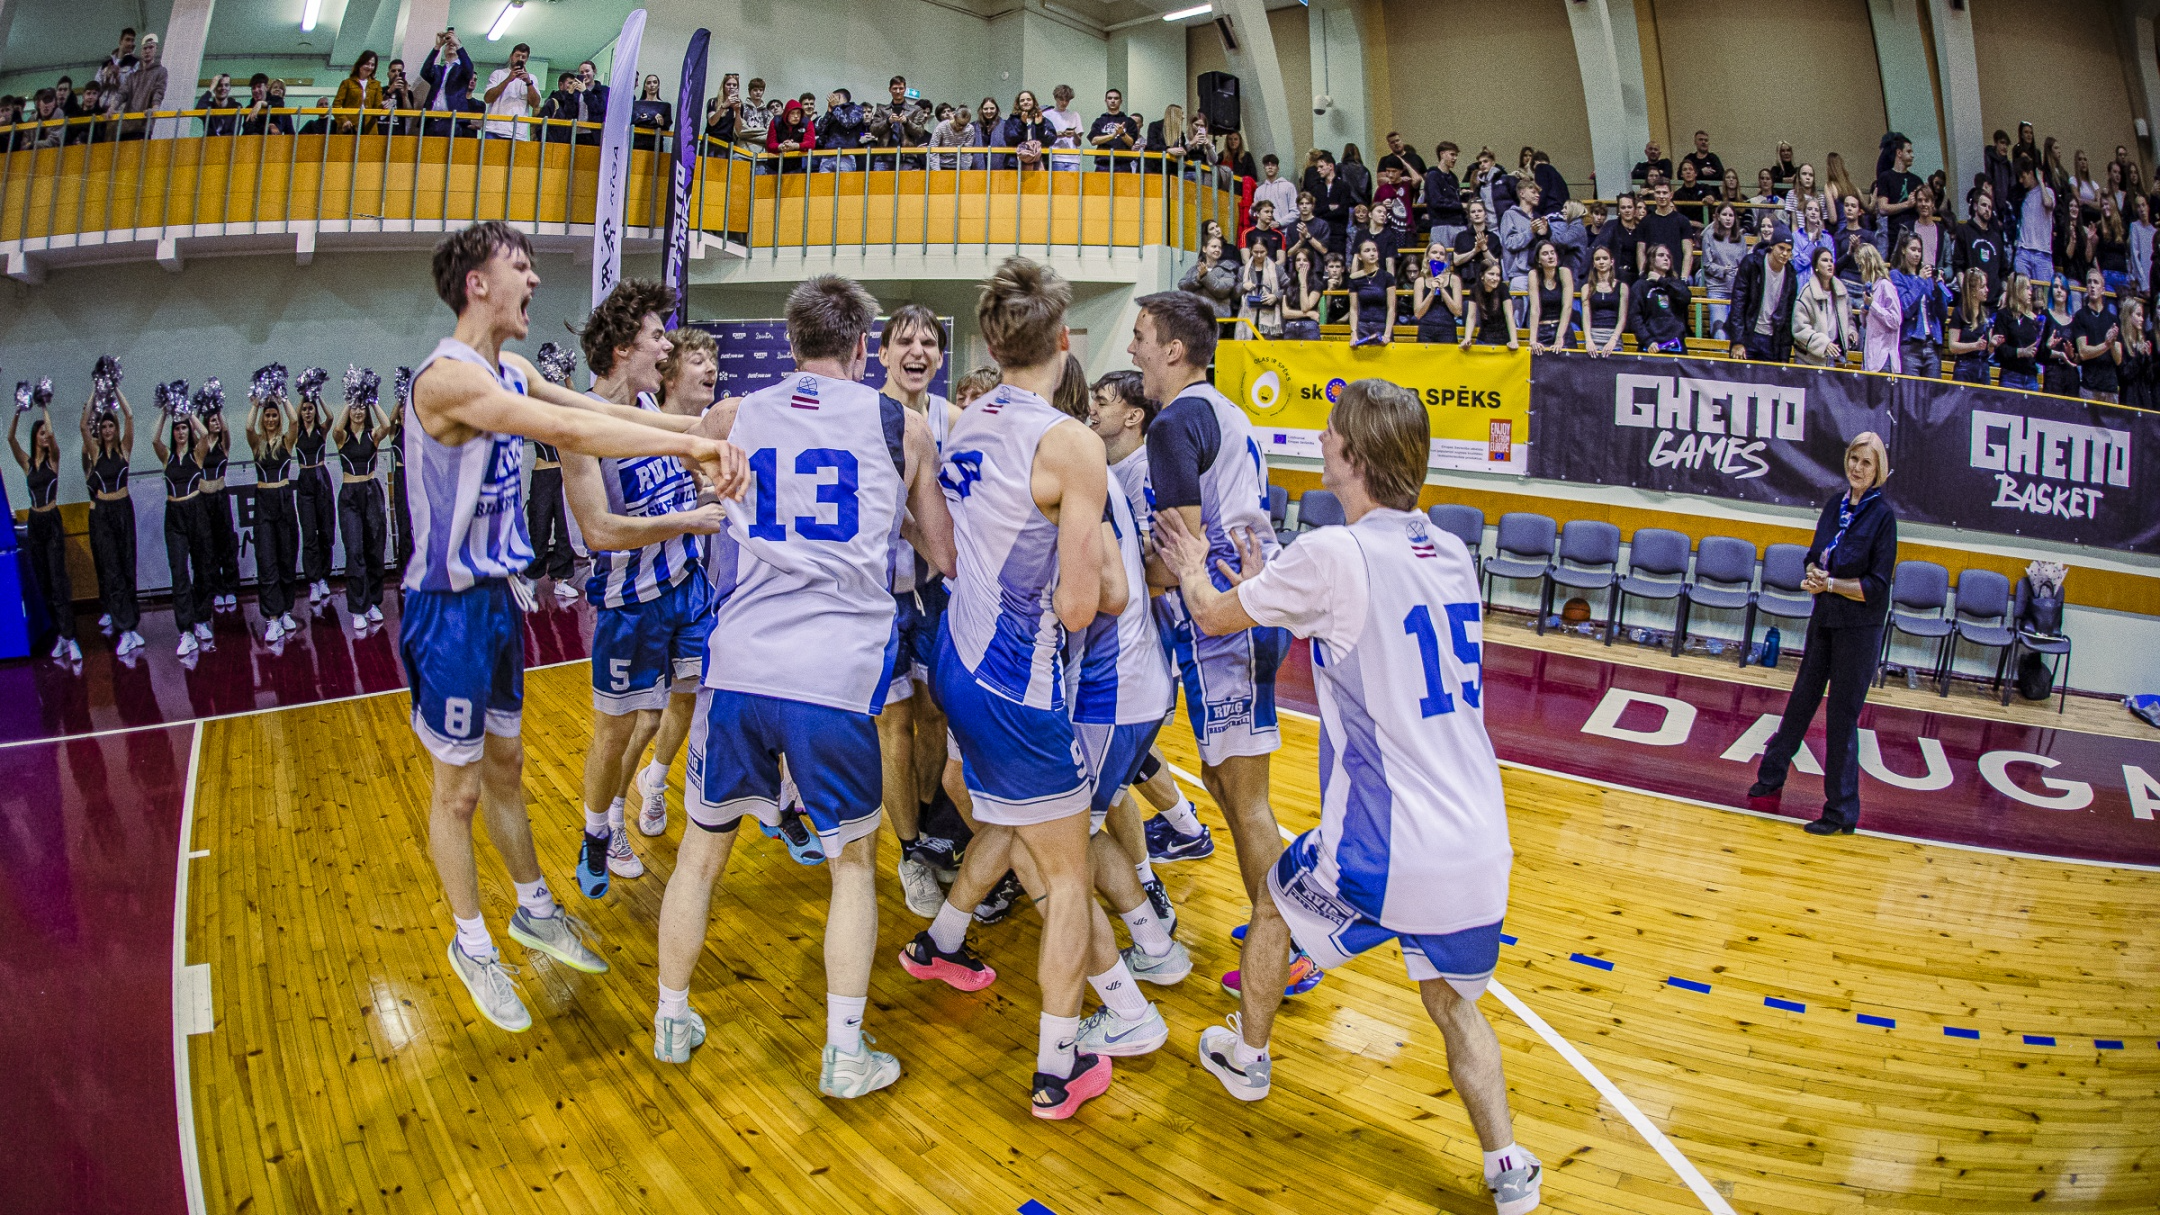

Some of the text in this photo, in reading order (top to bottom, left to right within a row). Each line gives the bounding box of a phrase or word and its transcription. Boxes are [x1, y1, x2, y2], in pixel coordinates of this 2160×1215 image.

[1425, 385, 1501, 409] SPĒKS
[1615, 373, 1806, 441] GHETTO
[1649, 430, 1770, 479] GAMES
[1970, 409, 2131, 488] GHETTO
[748, 447, 859, 542] 13
[1991, 473, 2104, 520] BASKET
[610, 658, 631, 691] 5
[1403, 602, 1481, 719] 15
[444, 697, 472, 738] 8
[1069, 737, 1089, 779] 9
